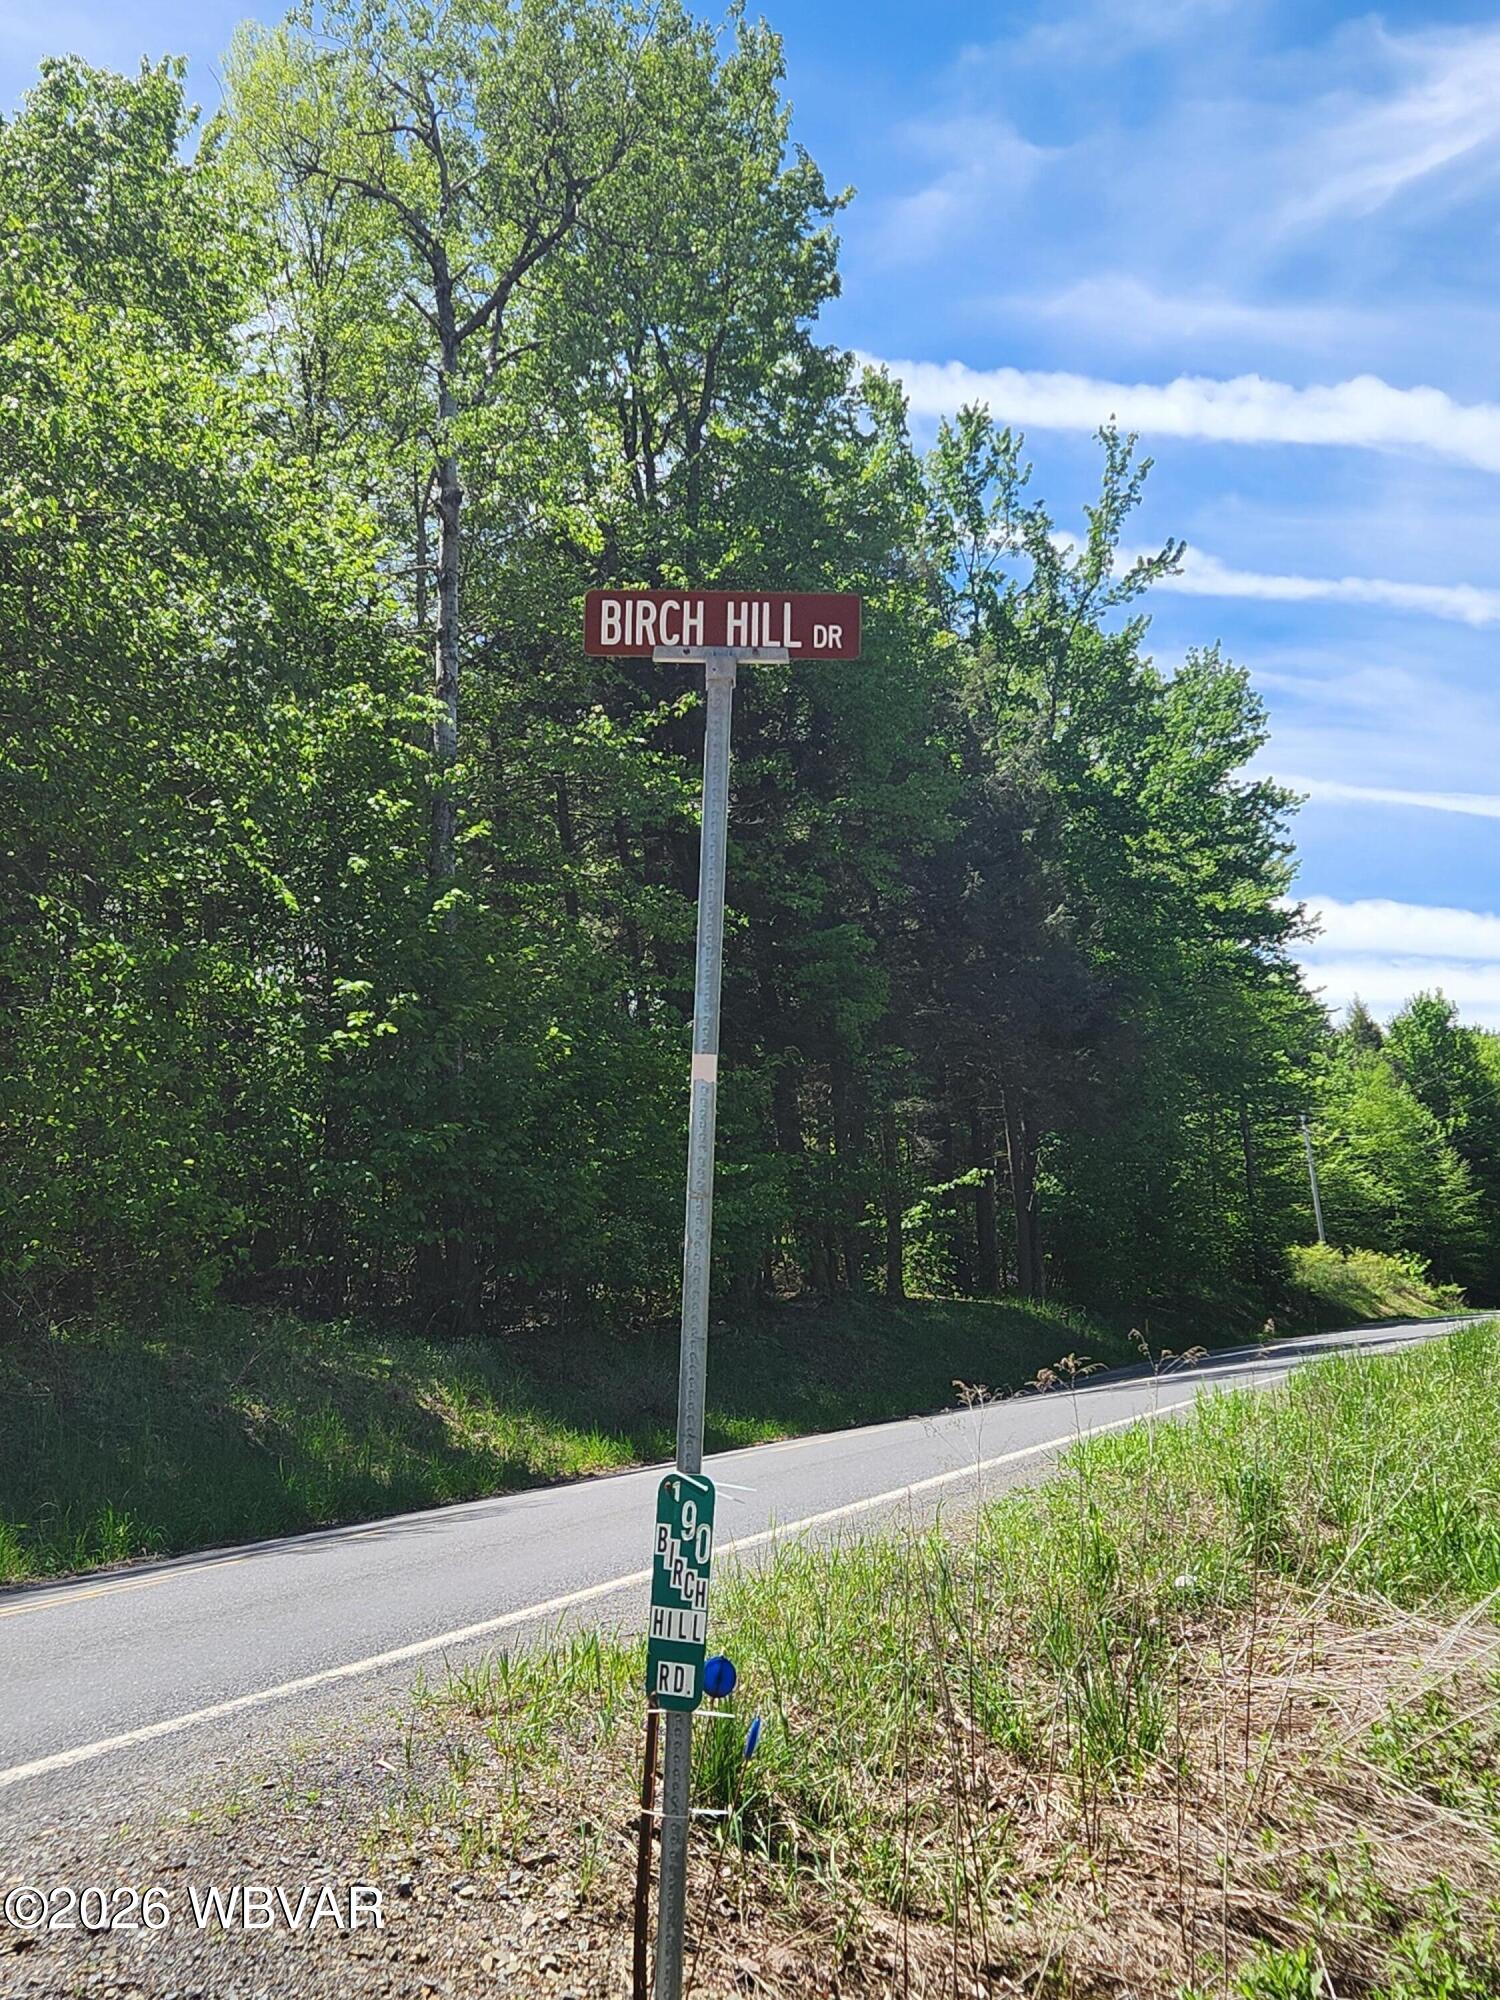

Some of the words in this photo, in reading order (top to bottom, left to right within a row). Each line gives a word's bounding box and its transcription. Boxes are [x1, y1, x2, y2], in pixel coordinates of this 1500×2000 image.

[600, 599, 704, 646] BIRCH
[727, 601, 802, 648] HILL
[813, 624, 842, 649] DR
[657, 1525, 707, 1608] BIRCH
[653, 1608, 701, 1642] HILL
[658, 1663, 691, 1695] RD.
